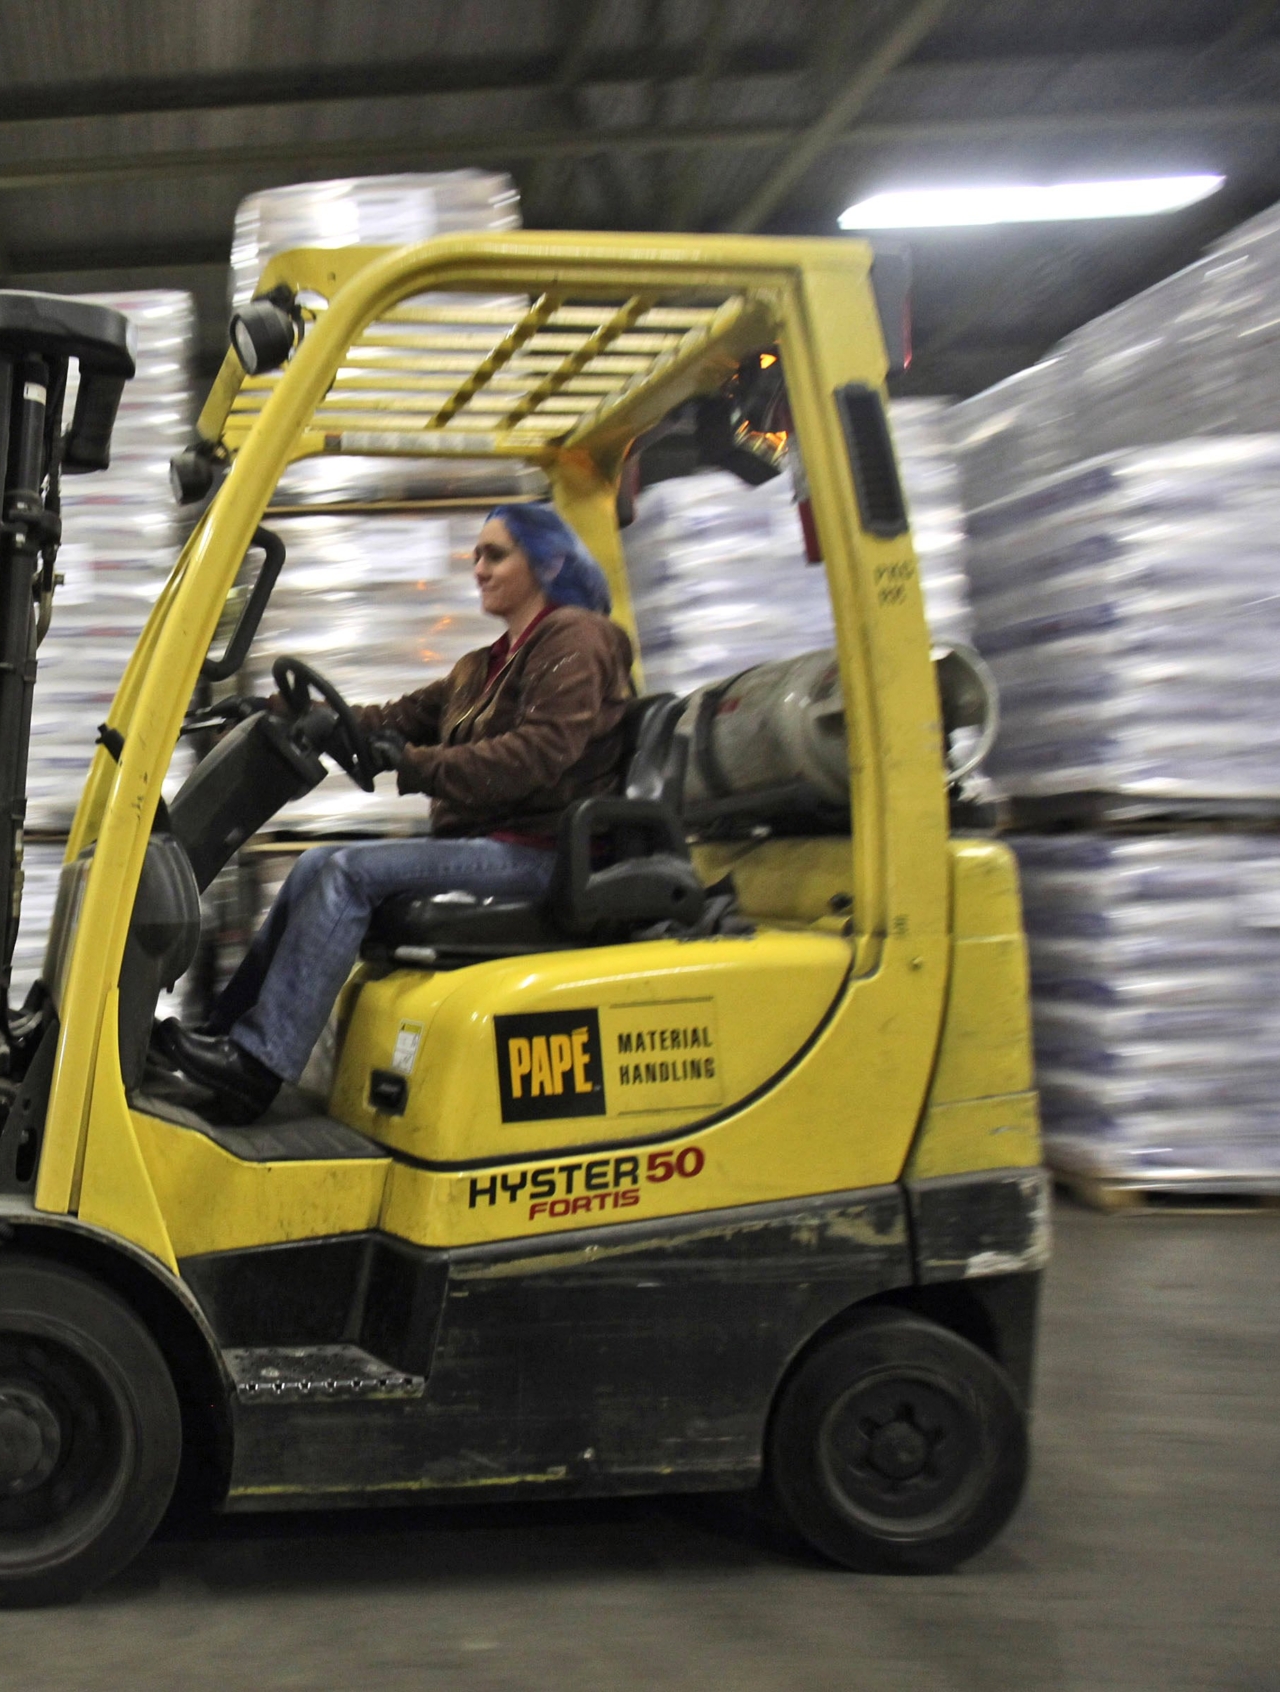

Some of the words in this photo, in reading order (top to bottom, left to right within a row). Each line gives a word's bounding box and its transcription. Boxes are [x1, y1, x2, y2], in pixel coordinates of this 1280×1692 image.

[617, 1026, 713, 1054] MATERIAL
[619, 1057, 716, 1086] HANDLING
[469, 1156, 640, 1209] HYSTER
[645, 1146, 706, 1184] 50
[528, 1188, 640, 1221] FORTIS
